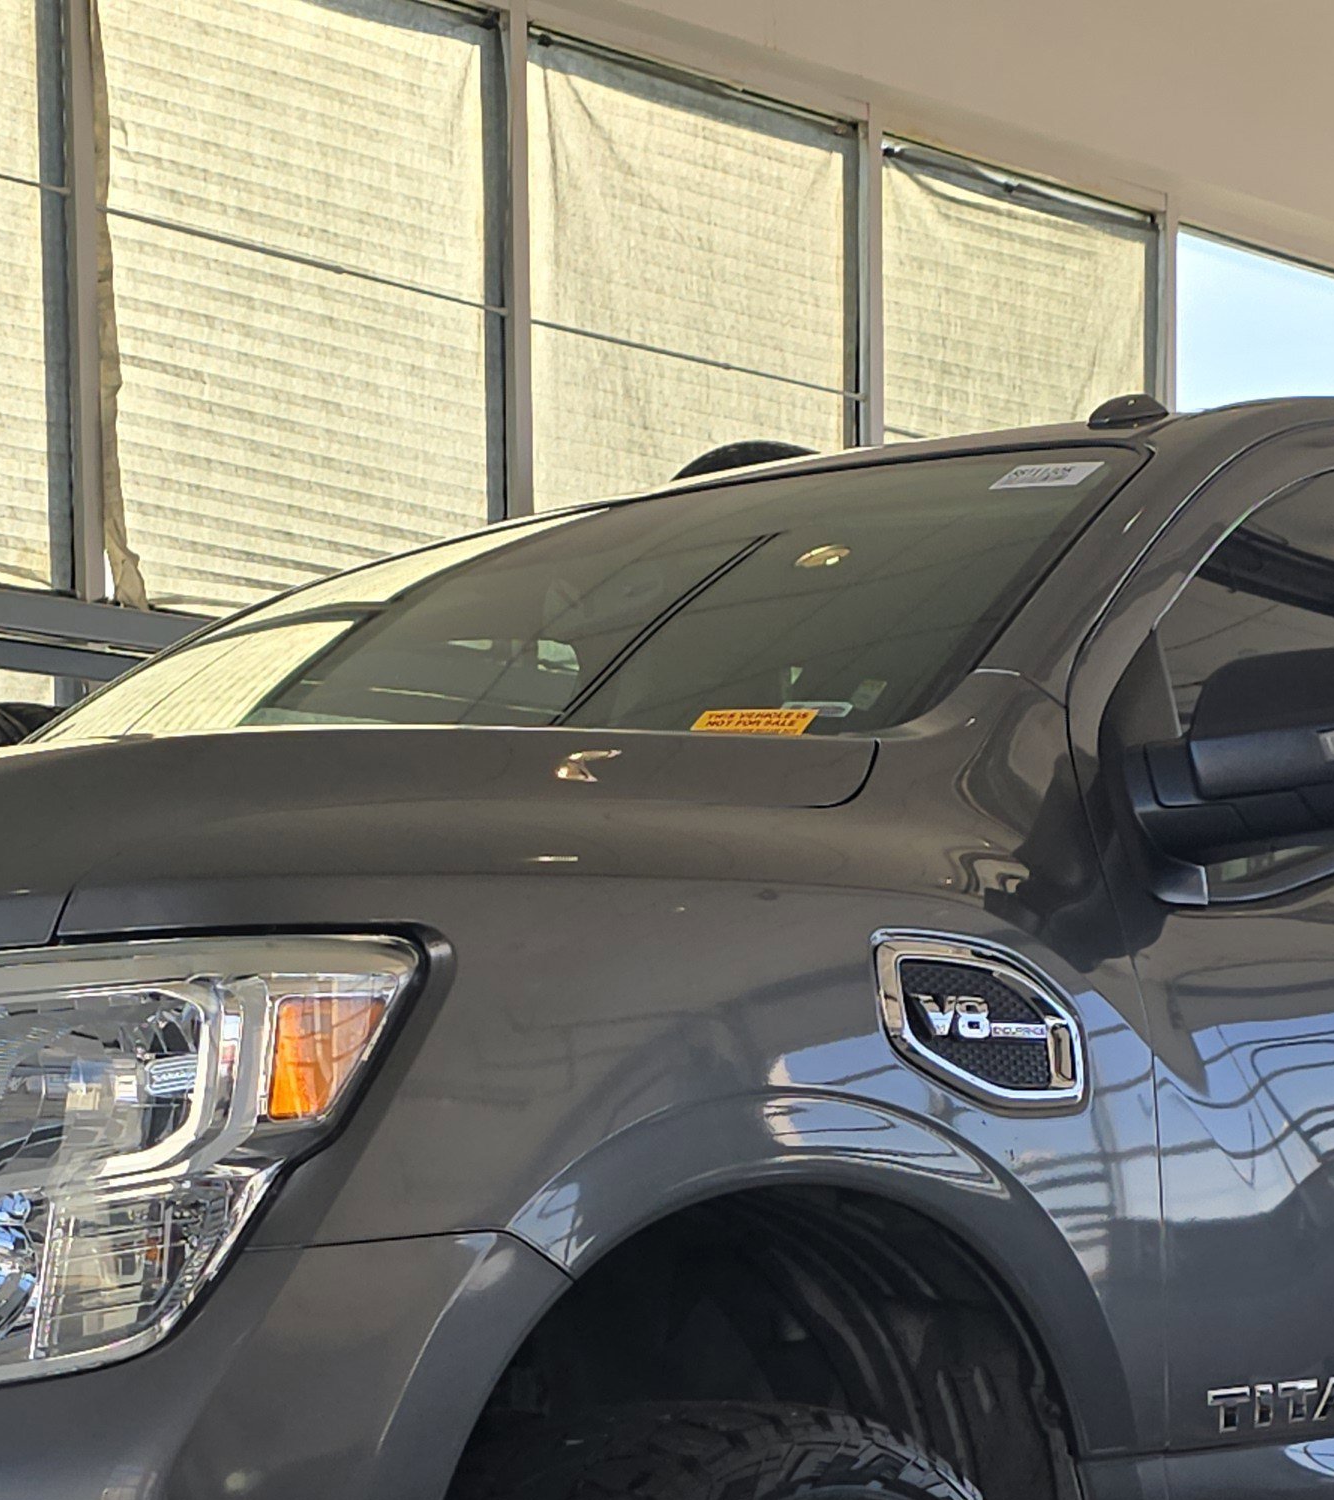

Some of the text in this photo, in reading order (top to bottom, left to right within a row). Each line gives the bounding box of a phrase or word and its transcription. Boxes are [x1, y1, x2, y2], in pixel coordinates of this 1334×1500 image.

[707, 711, 809, 720] THIS VEHICLE IS
[915, 993, 991, 1040] V8
